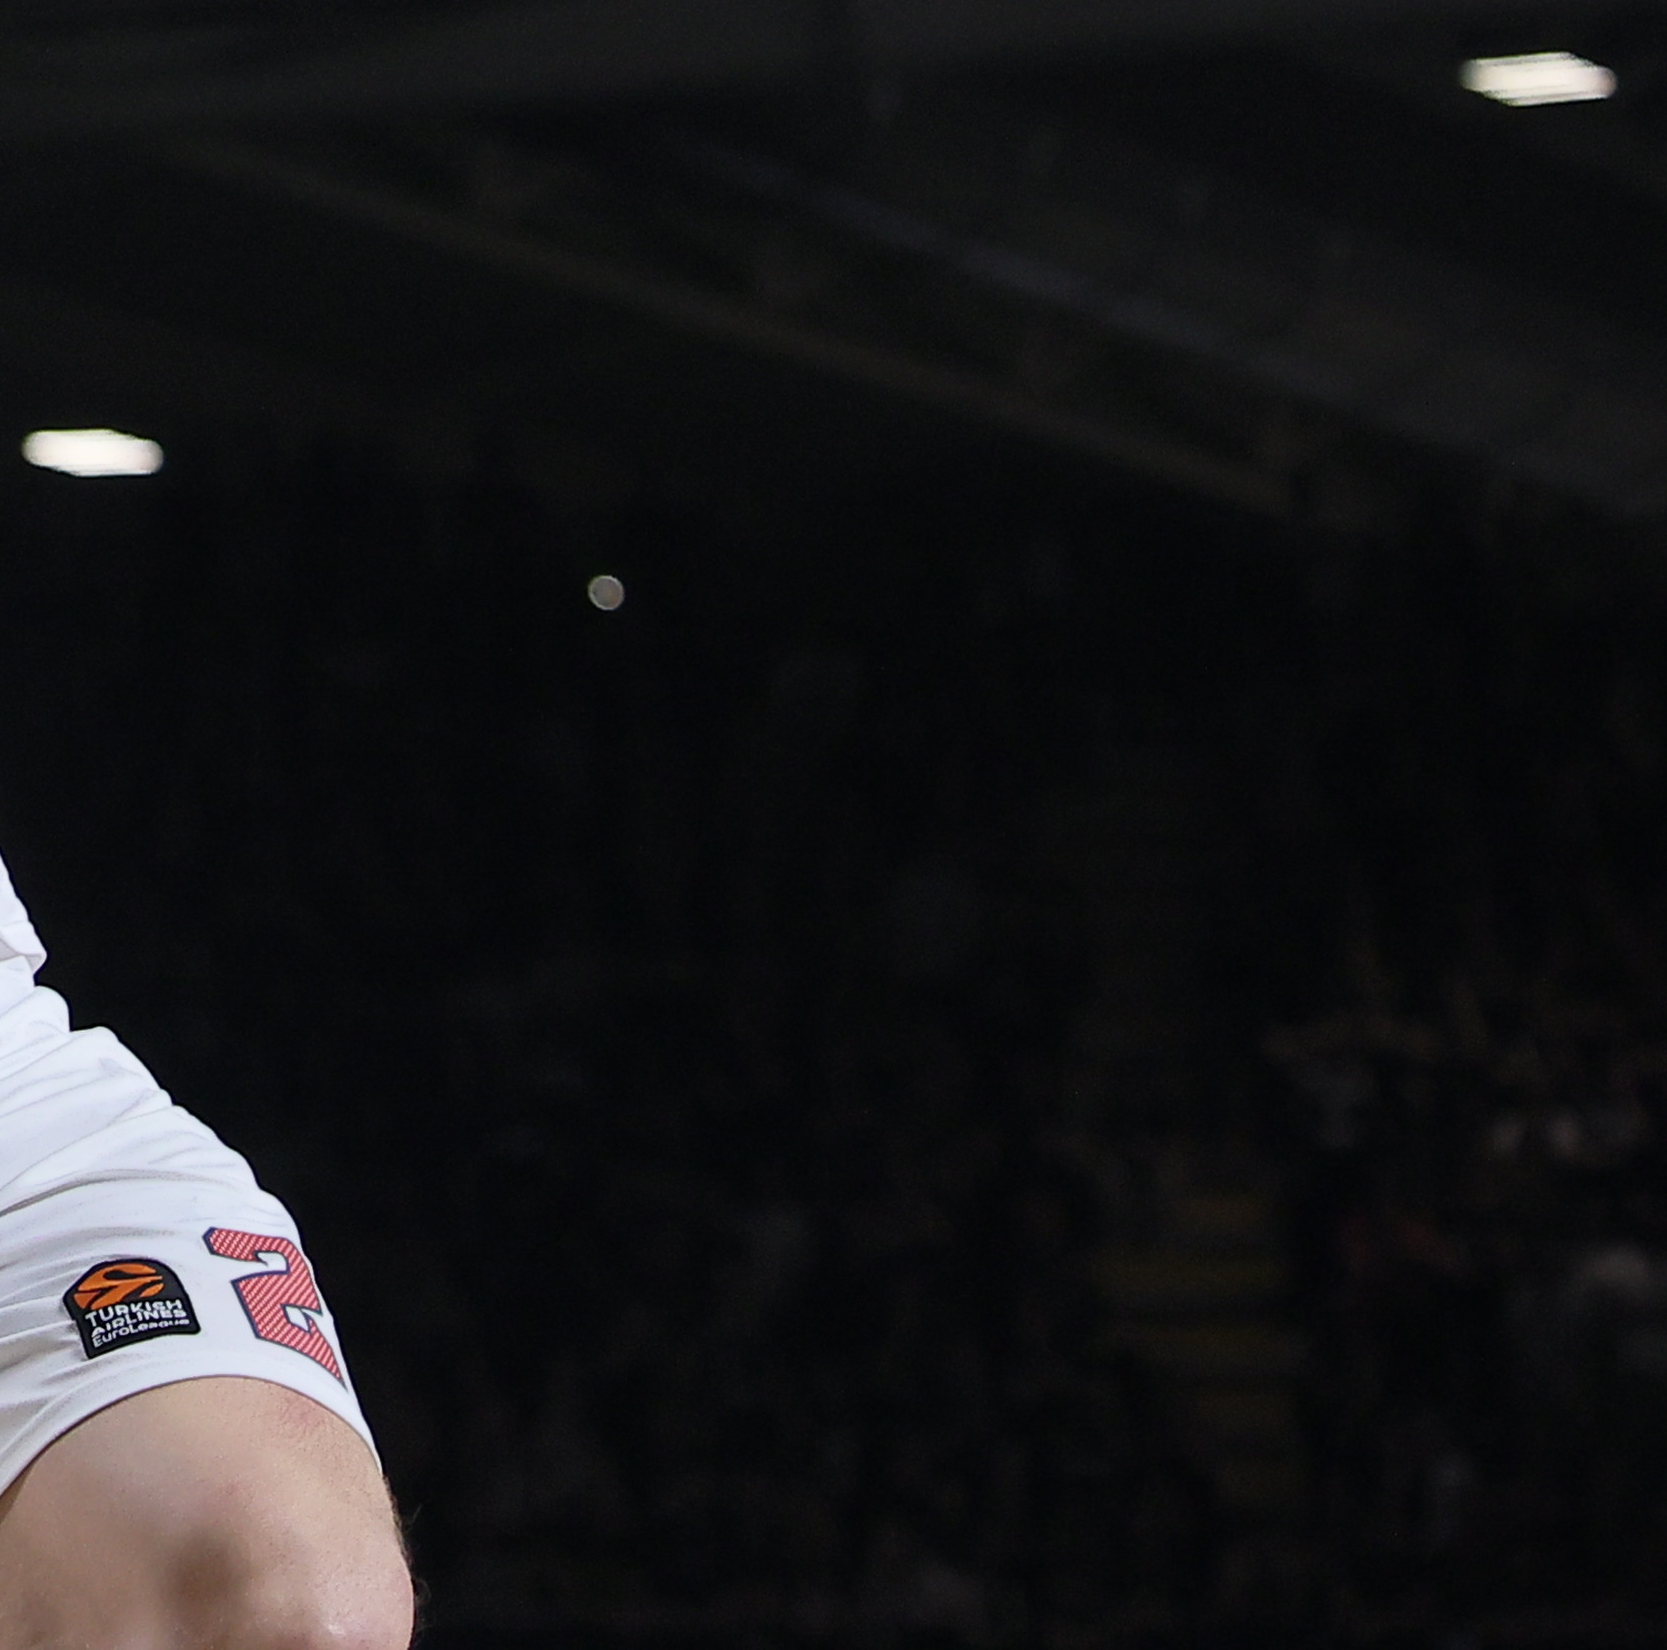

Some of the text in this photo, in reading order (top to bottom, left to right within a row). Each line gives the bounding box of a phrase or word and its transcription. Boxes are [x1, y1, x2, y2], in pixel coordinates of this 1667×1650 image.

[85, 1299, 183, 1326] TURKISH
[91, 1309, 187, 1337] AIRLINES
[92, 1319, 190, 1348] EuroLeague
